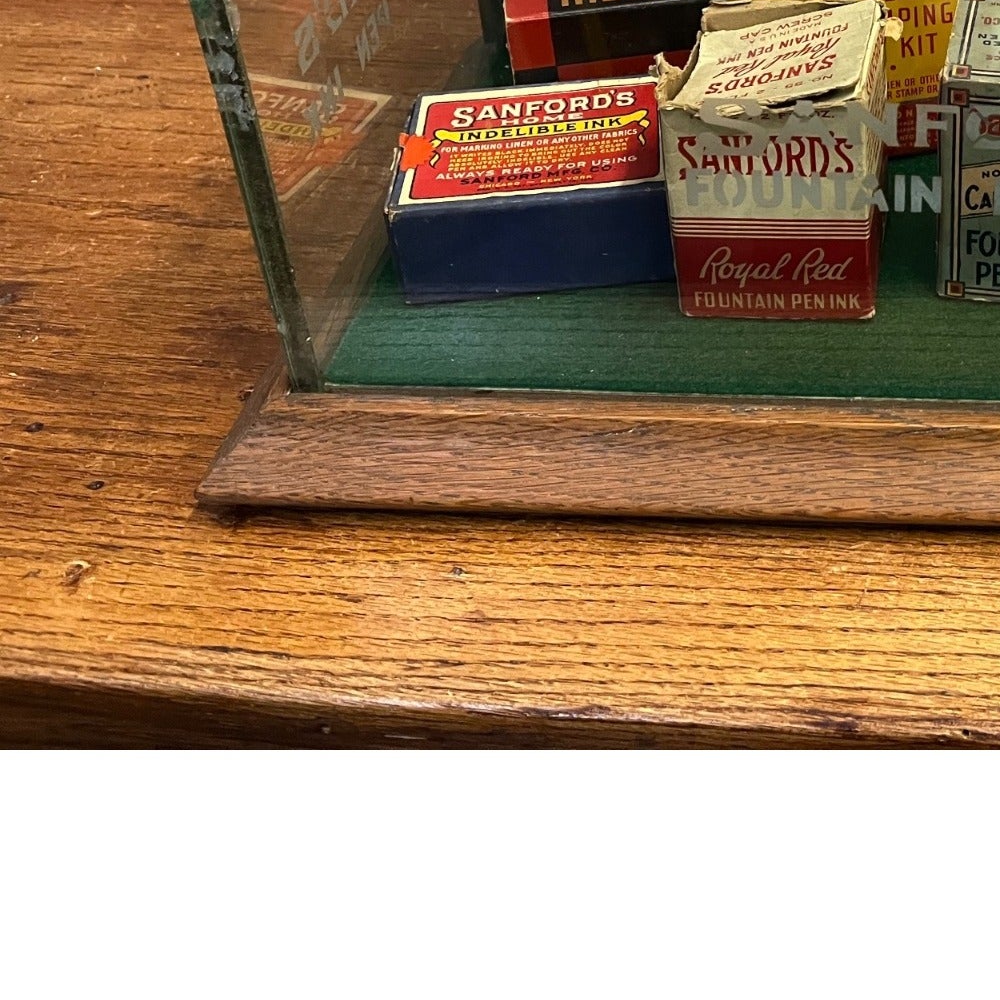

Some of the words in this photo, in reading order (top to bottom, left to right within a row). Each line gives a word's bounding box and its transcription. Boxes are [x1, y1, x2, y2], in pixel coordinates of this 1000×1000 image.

[776, 11, 833, 30] SCREW
[888, 3, 953, 28] PING
[981, 16, 1000, 25] CO.
[740, 27, 771, 41] CAP
[779, 22, 849, 50] FOUNTAIN
[747, 43, 774, 59] PEN
[900, 32, 938, 59] KIT
[716, 52, 742, 66] INK
[704, 53, 837, 95] SANFORD'S
[905, 77, 916, 87] OR
[896, 86, 925, 99] STAMP
[927, 84, 938, 94] OR
[451, 89, 636, 128] SANFORD'S
[501, 112, 584, 126] HOME
[459, 122, 577, 141] INDELIBLE
[584, 117, 623, 130] INK
[460, 143, 503, 152] MARKING
[506, 140, 533, 148] LINEN
[536, 138, 549, 146] OR
[552, 136, 571, 144] ANY
[571, 133, 599, 142] OTHER
[602, 129, 638, 139] FABRICS
[436, 169, 495, 180] ALWAYS
[501, 164, 553, 175] READY
[557, 161, 587, 170] FOR
[591, 155, 638, 167] USING
[460, 172, 542, 185] SANFORD
[685, 168, 943, 214] FOUNTAIN
[700, 246, 791, 289] Royal
[792, 247, 853, 285] Red
[694, 291, 785, 309] FOUNTAIN
[792, 293, 826, 310] PEN
[830, 293, 861, 310] INK
